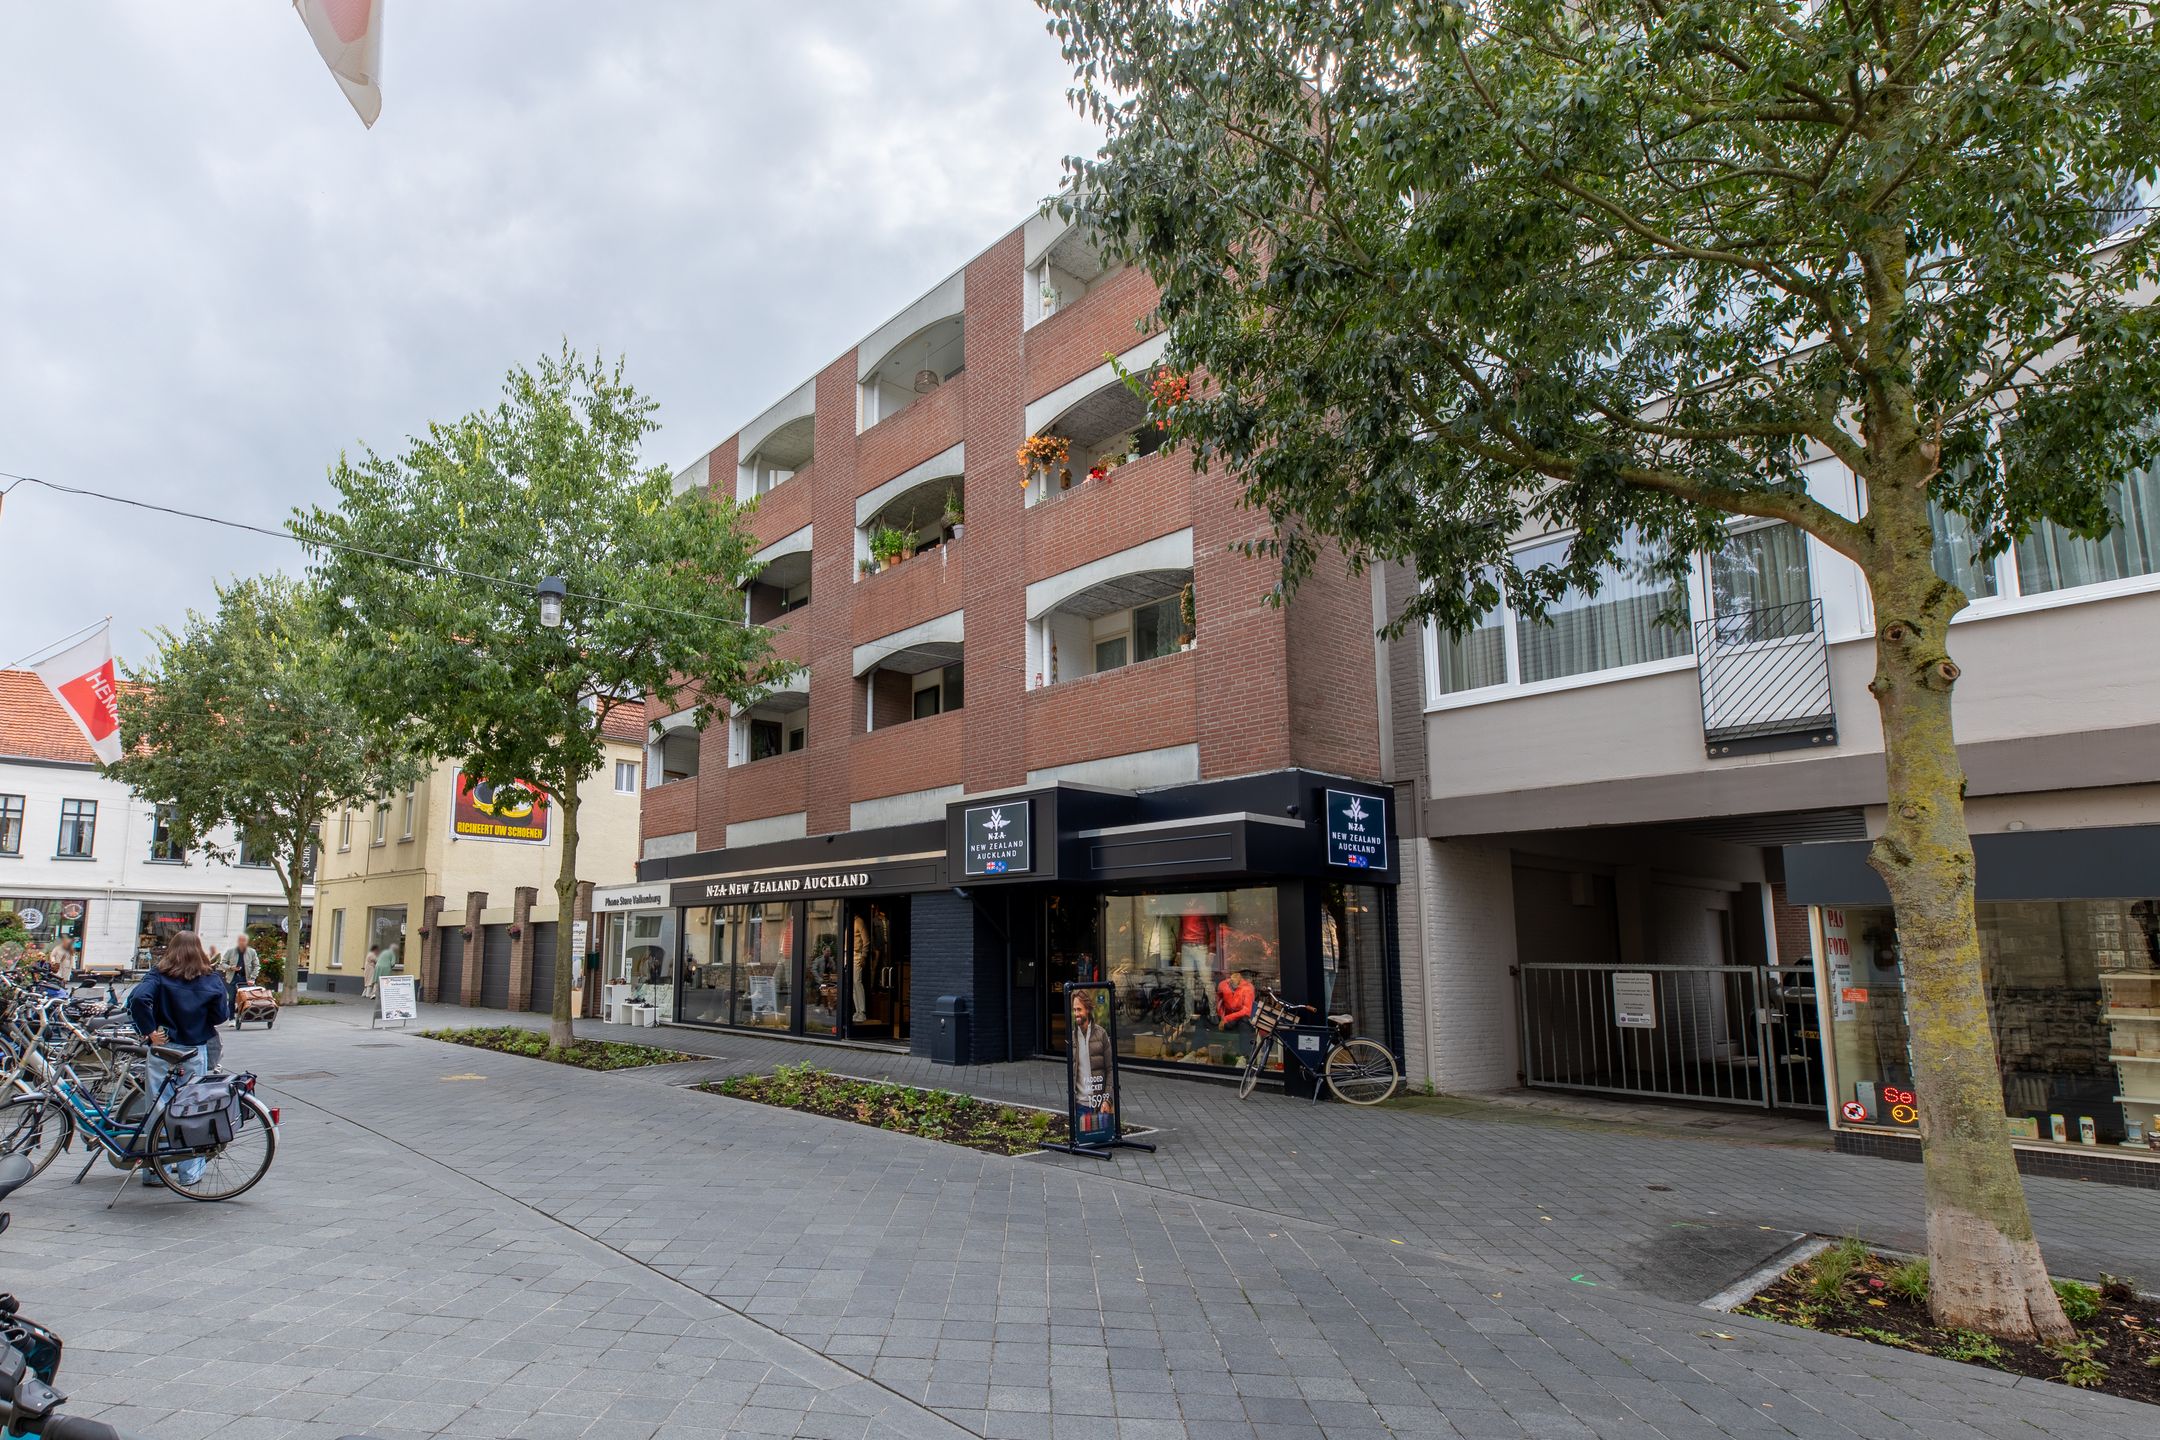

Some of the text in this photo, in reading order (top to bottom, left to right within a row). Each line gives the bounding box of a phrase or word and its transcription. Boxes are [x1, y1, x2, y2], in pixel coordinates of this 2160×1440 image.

[494, 825, 508, 836] UW
[507, 826, 543, 839] SCHOENEN
[1332, 832, 1381, 845] NEW ZEALAND
[970, 840, 1024, 852] NEW ZEALAND
[1338, 842, 1376, 854] AUCKLAND
[977, 850, 1017, 860] AUCKLAND
[753, 879, 800, 893] ZEALAND
[803, 873, 870, 890] AUCKLAND
[605, 893, 662, 907] Phone Store Valkenburg
[1827, 910, 1844, 928] PAS
[1827, 937, 1849, 956] FOTO
